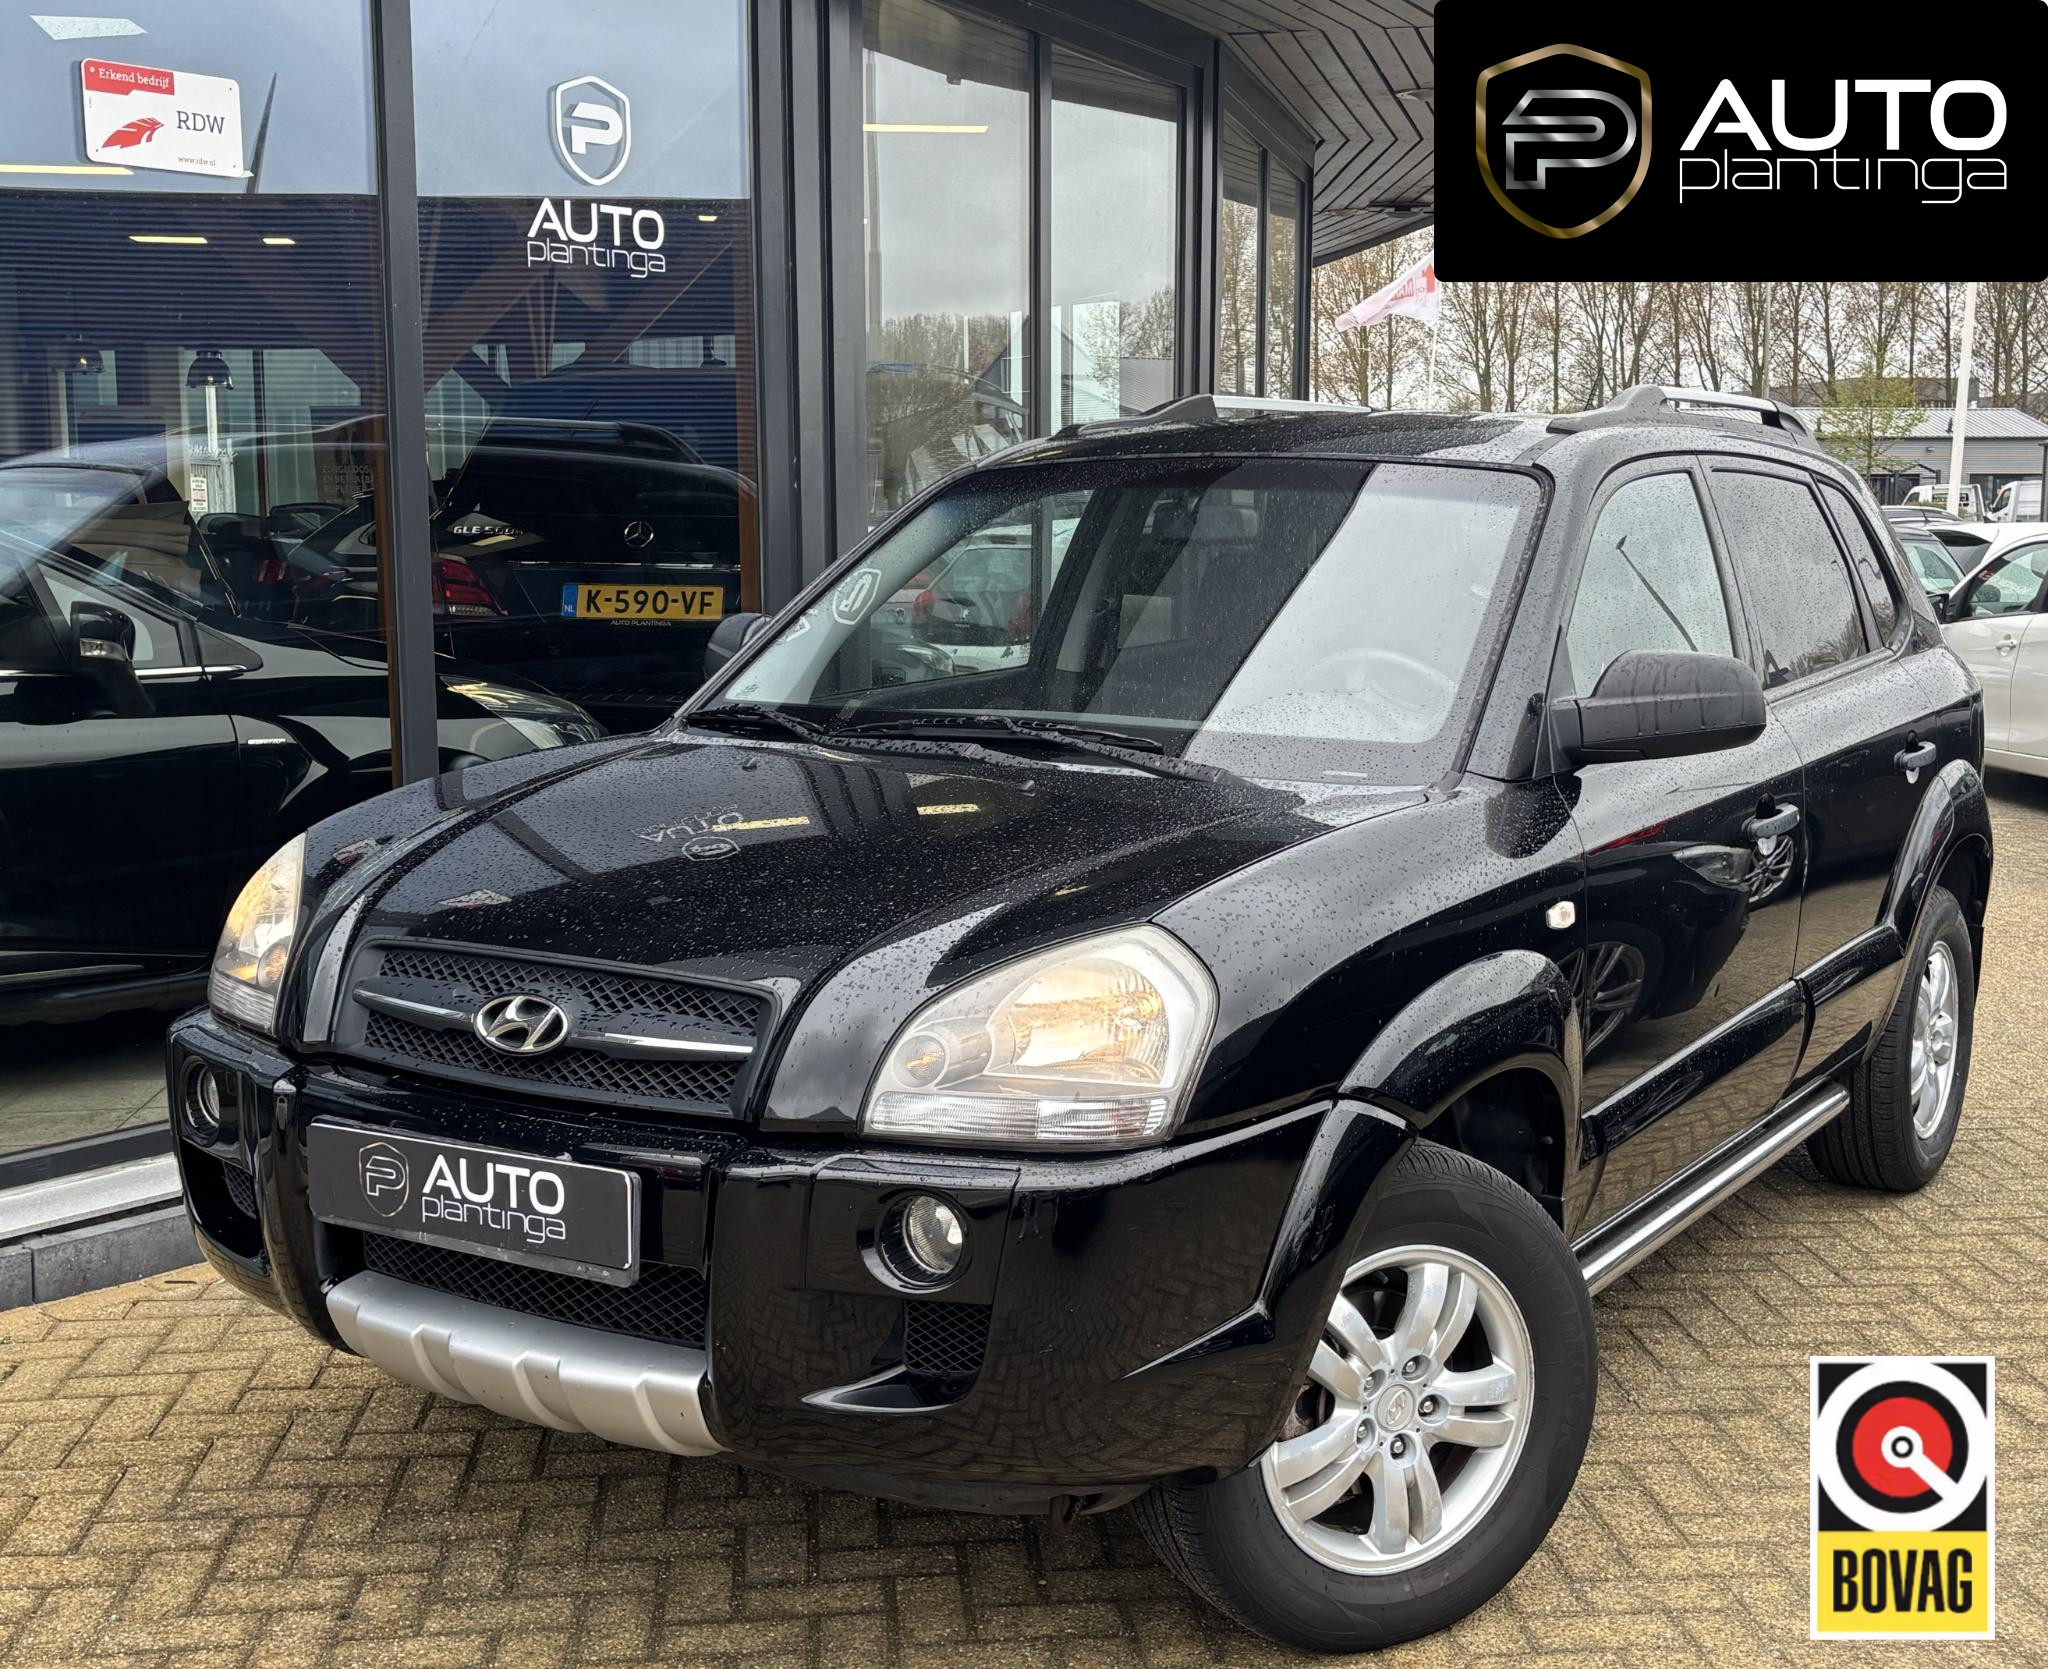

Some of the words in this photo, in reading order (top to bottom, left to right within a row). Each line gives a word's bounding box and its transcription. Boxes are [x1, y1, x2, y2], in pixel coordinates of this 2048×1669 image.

[98, 67, 135, 83] Erkend
[136, 72, 170, 89] bedrijf
[176, 110, 225, 135] RDW
[178, 156, 217, 167] www.rdw.nl
[527, 197, 665, 250] AUTO
[527, 237, 666, 278] plantinga
[585, 587, 715, 616] K-590-VF
[610, 619, 630, 627] AUTO
[631, 619, 672, 628] PLANTINGA
[421, 1153, 566, 1216] AUTO
[421, 1193, 567, 1244] plantinga
